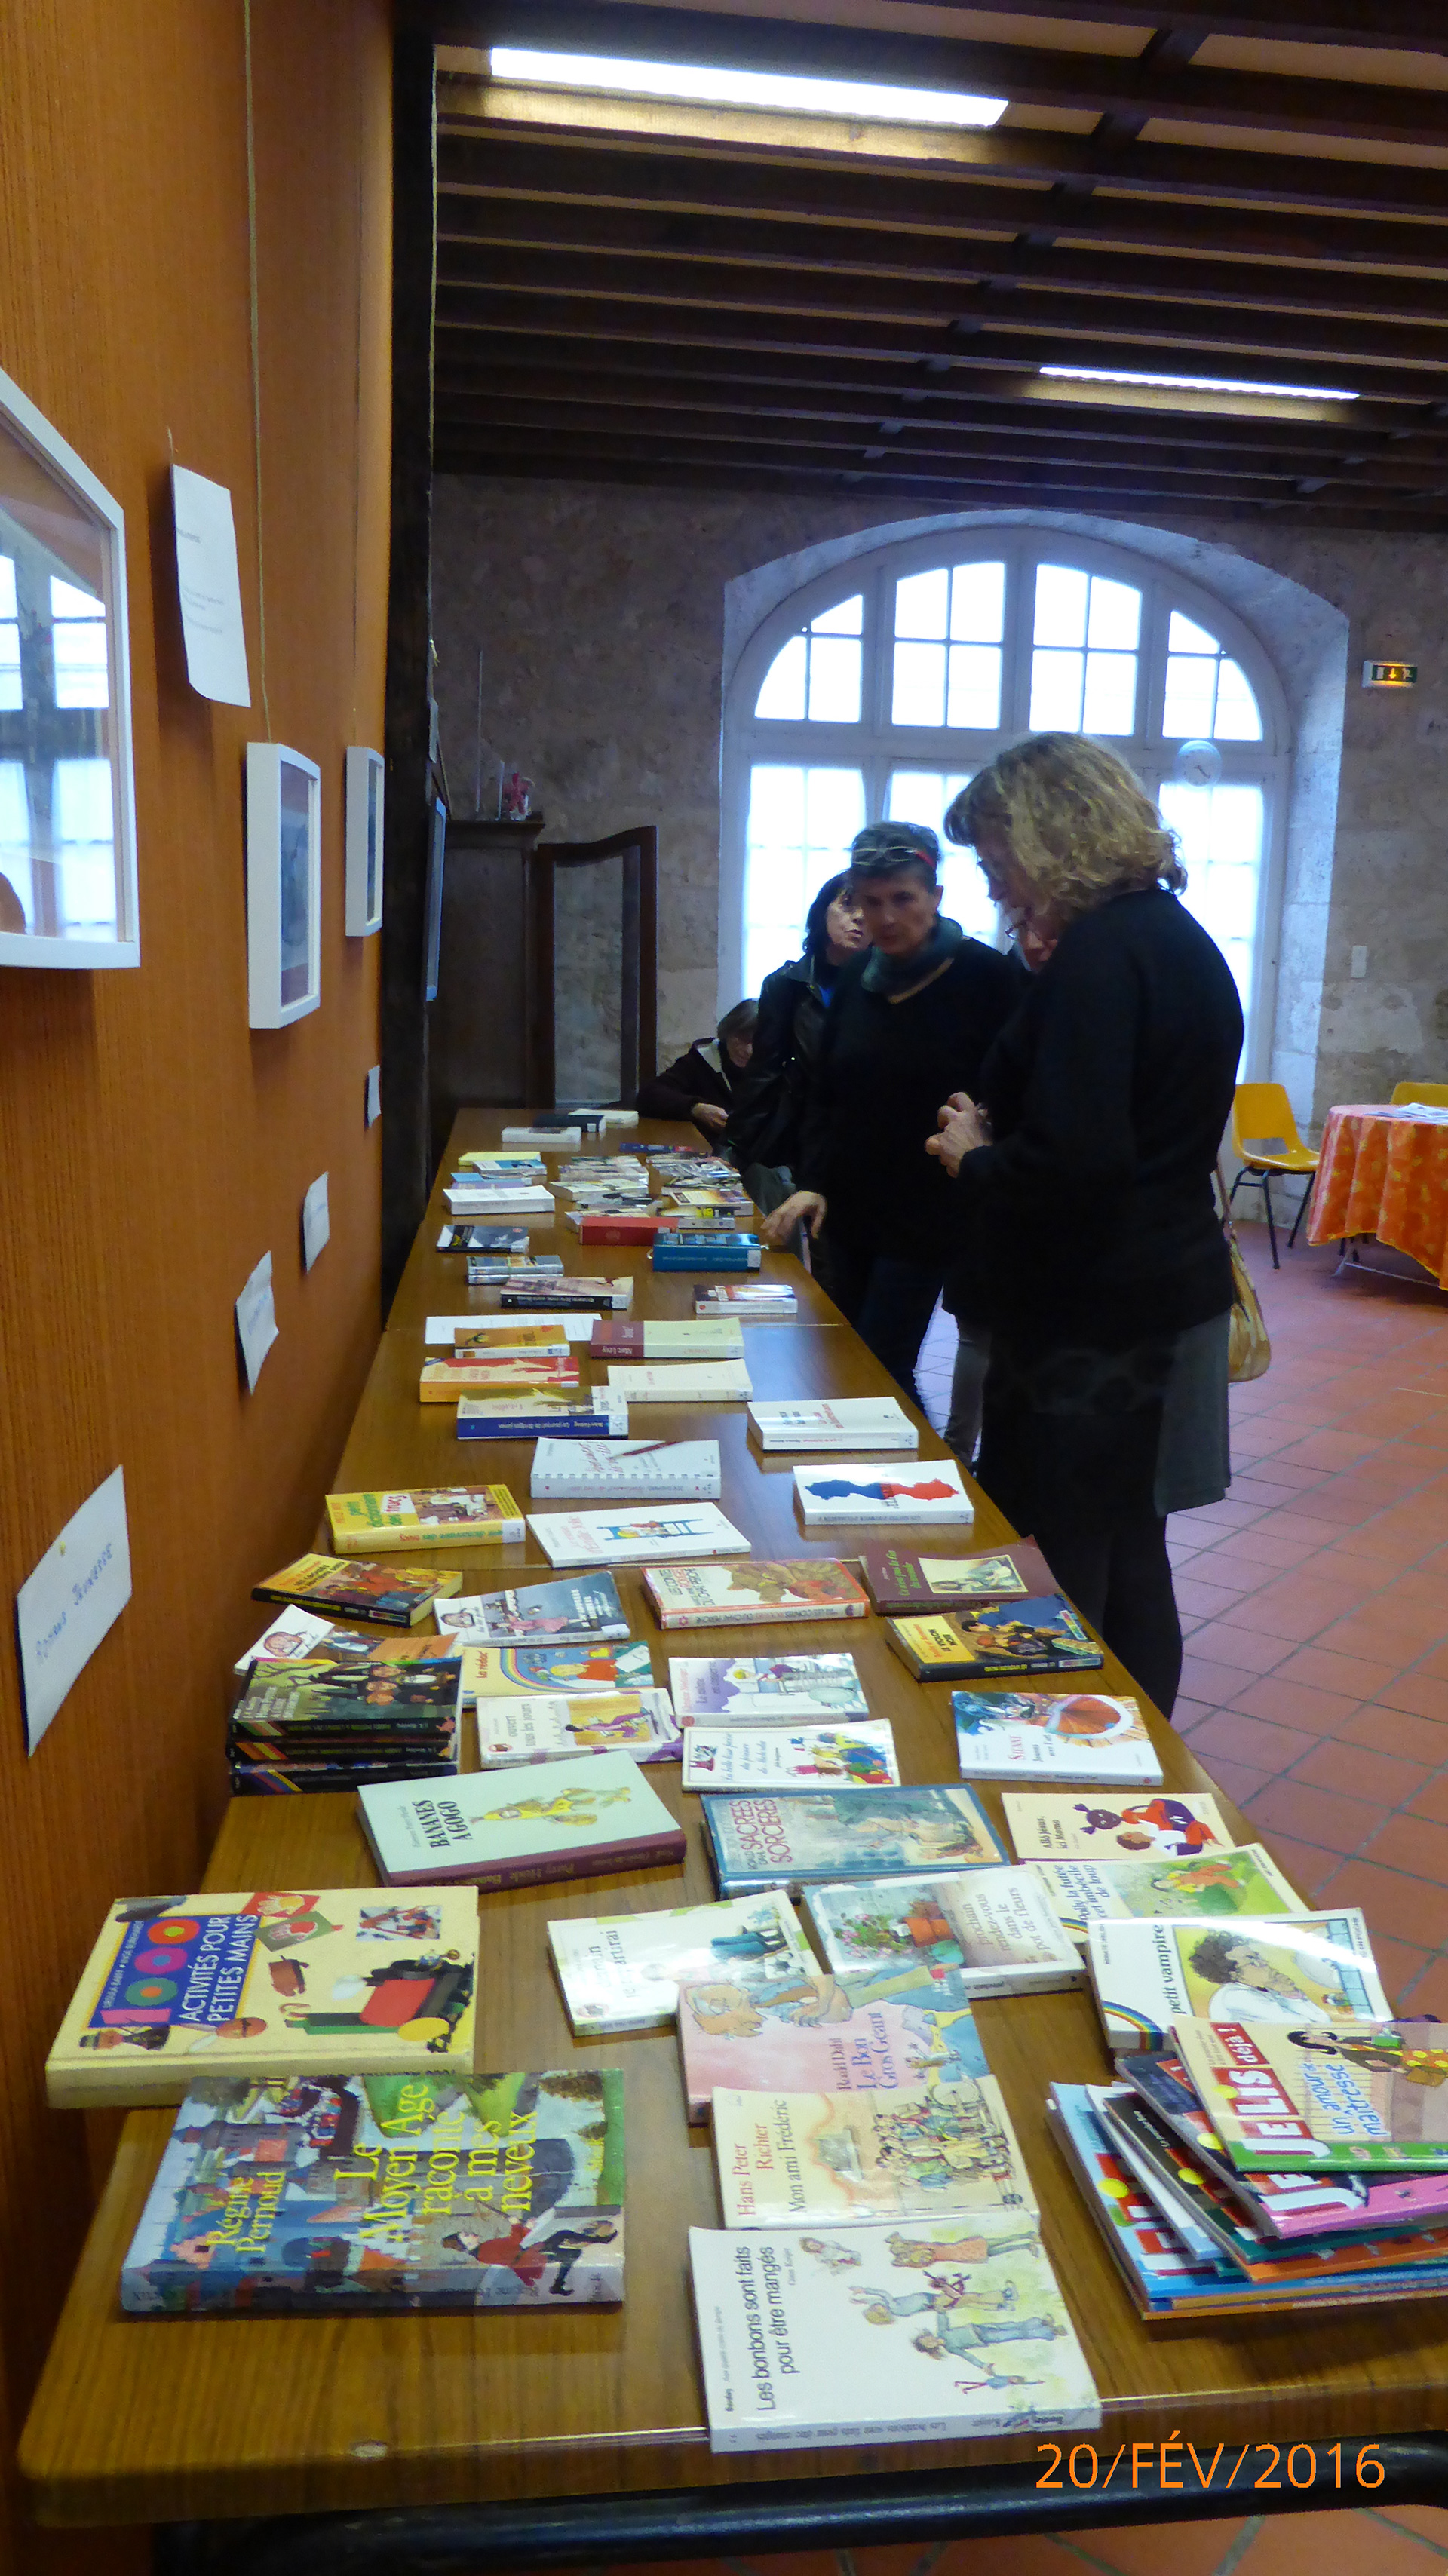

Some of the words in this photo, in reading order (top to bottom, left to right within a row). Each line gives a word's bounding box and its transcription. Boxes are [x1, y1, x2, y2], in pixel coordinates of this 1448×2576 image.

[411, 1799, 452, 1848] BANANES
[437, 1800, 468, 1833] GOGO
[1052, 1820, 1065, 1840] Momo
[1052, 1865, 1075, 1888] futée
[1067, 1865, 1098, 1903] imbécile
[1082, 1865, 1103, 1884] loup
[994, 1903, 1011, 1914] le
[1007, 1887, 1031, 1917] fleurs
[1097, 1888, 1111, 1897] de
[959, 1903, 992, 1946] prochain
[972, 1893, 1012, 1952] rendez-vous
[1002, 1915, 1023, 1940] dans
[1020, 1919, 1038, 1931] de
[1072, 1900, 1091, 1921] Polly
[1092, 1905, 1107, 1918] cet
[224, 1914, 259, 1962] MAINS
[1032, 1934, 1051, 1951] pot
[1152, 1924, 1173, 1983] vampire
[100, 1918, 200, 2024] 1000
[179, 1954, 220, 2022] ACTIVITÉS
[200, 1915, 232, 1952] POUR
[206, 1967, 244, 2022] PETITES
[1163, 1987, 1187, 2014] petit
[867, 2012, 890, 2053] Géant
[1225, 2035, 1259, 2063] déjà
[851, 2037, 872, 2066] Bon
[1300, 2062, 1316, 2072] de
[855, 2068, 879, 2090] Le
[877, 2055, 900, 2090] Gros
[1303, 2072, 1338, 2111] amour
[1324, 2064, 1389, 2136] maîtresse
[770, 2099, 796, 2151] Frédéric
[1332, 2117, 1355, 2134] Un
[334, 2143, 382, 2182] Le
[421, 2110, 466, 2216] raconté
[468, 2119, 505, 2176] mes
[499, 2110, 538, 2213] neveux
[730, 2143, 753, 2176] Peter
[753, 2123, 775, 2171] Richter
[358, 2149, 422, 2246] Moyen
[392, 2083, 435, 2136] Age
[779, 2155, 802, 2182] ami
[206, 2173, 255, 2249] Régine
[234, 2170, 287, 2255] Pernoud
[737, 2180, 758, 2216] Hans
[787, 2184, 808, 2213] Mon
[734, 2246, 753, 2276] faits
[756, 2246, 783, 2305] mangés
[738, 2279, 759, 2311] sont
[768, 2308, 789, 2336] être
[745, 2314, 771, 2378] bonbons
[775, 2340, 801, 2374] pour
[756, 2382, 776, 2411] Les
